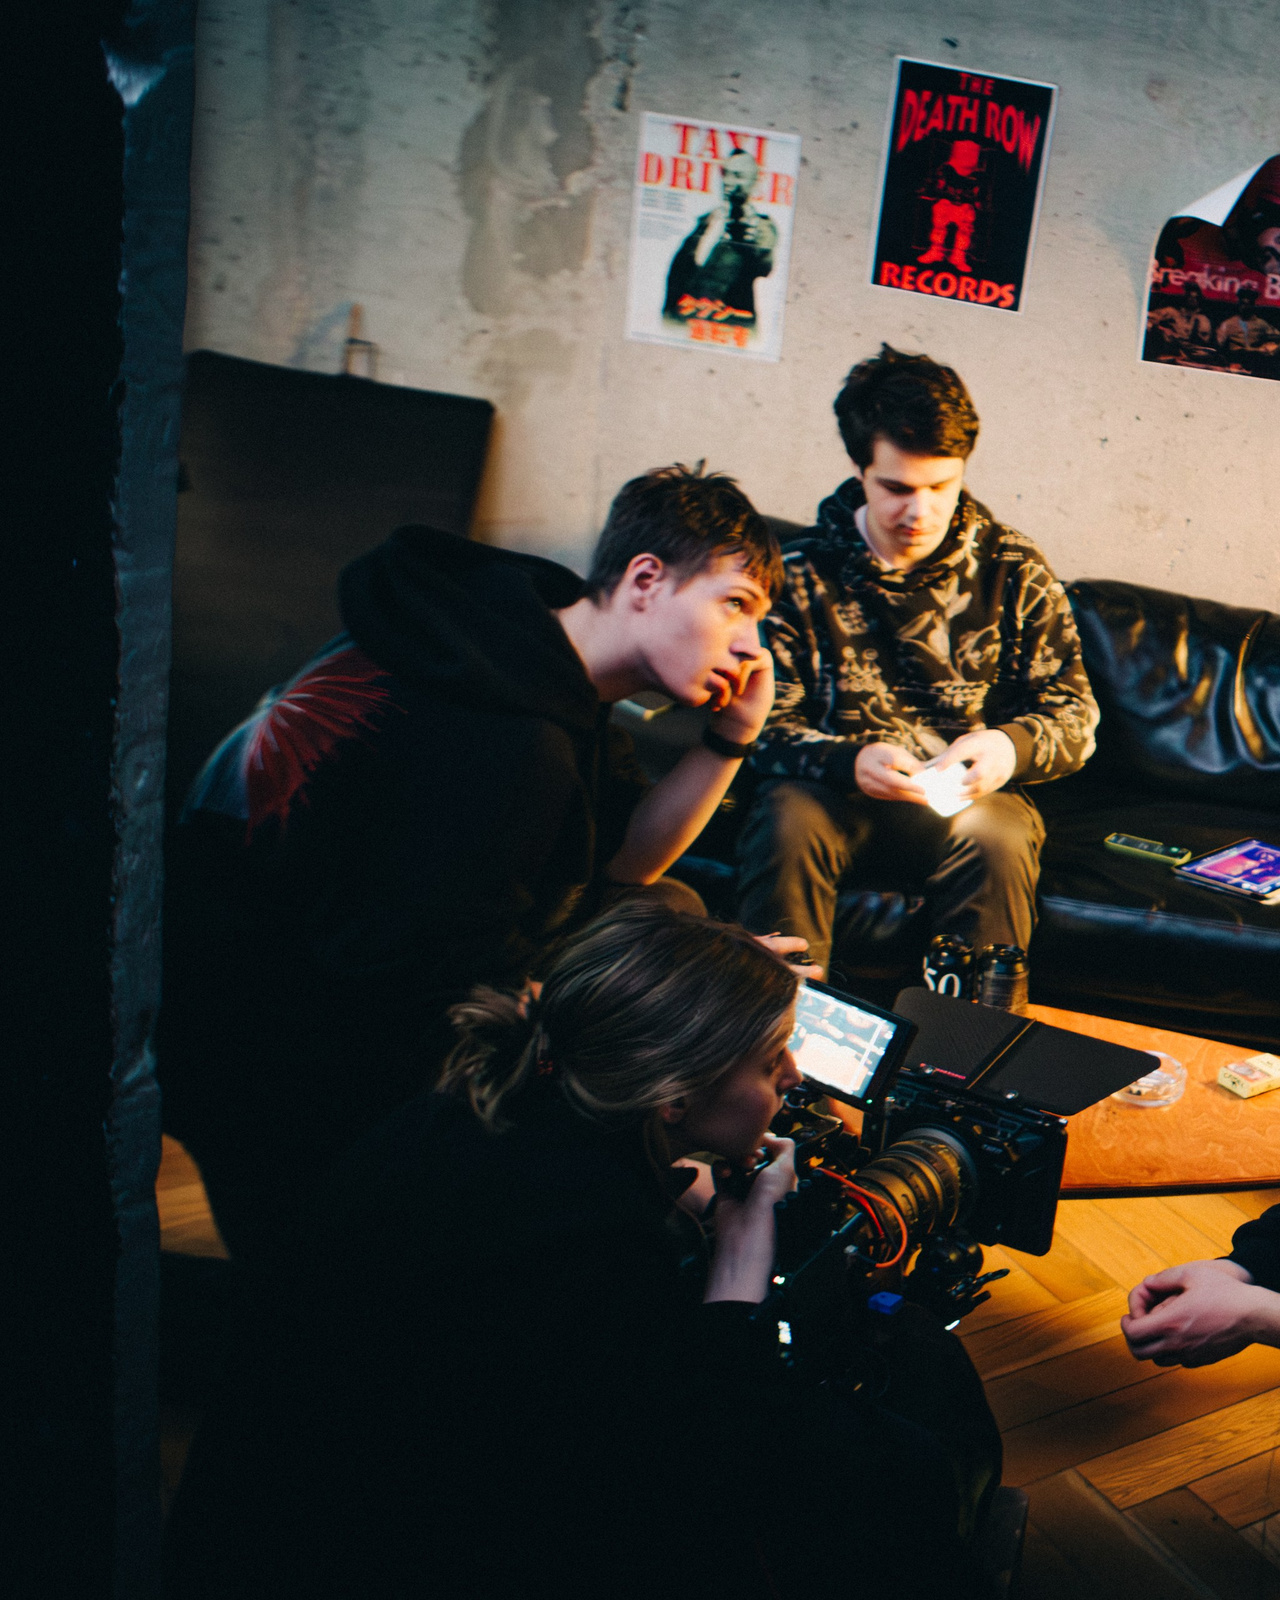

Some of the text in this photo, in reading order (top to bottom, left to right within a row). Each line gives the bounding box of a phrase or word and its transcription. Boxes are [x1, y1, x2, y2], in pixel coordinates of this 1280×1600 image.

[959, 73, 995, 96] THE
[897, 89, 1041, 173] DEATH ROW
[879, 261, 1016, 308] RECORDS
